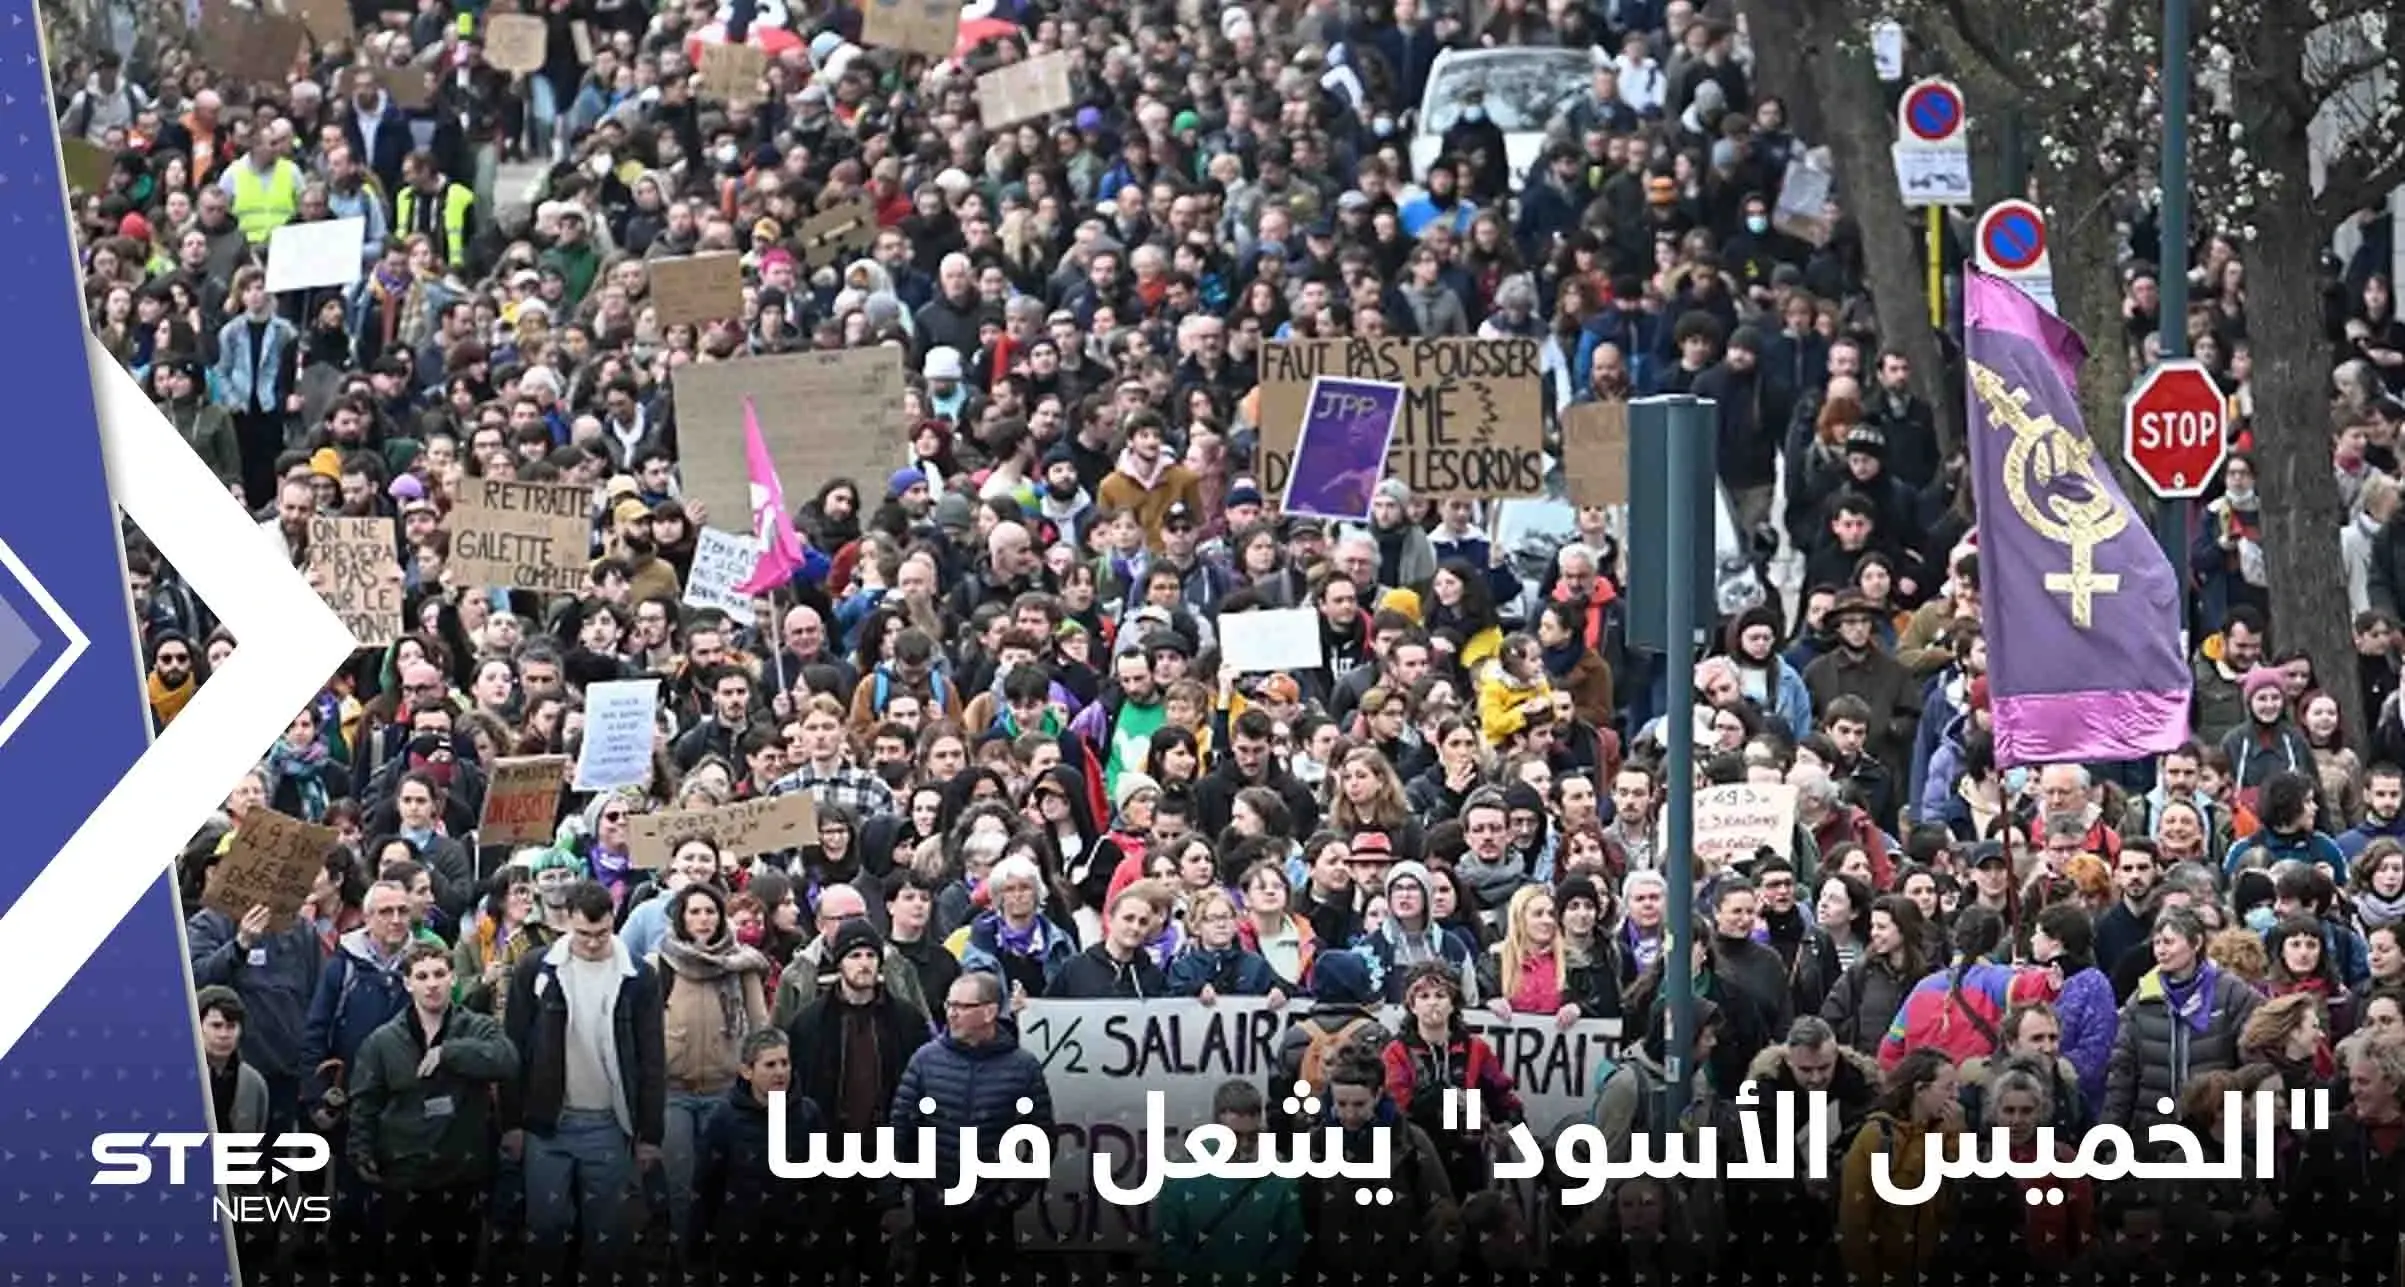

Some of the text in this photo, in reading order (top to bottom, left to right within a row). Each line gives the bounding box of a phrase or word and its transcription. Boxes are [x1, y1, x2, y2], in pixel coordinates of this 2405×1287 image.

[1262, 337, 1541, 381] FAUT PAS POUSSER
[1391, 377, 1460, 448] MÉ
[2140, 410, 2217, 450] STOP
[484, 480, 593, 519] RETRAITE
[313, 519, 380, 541] ON NE
[456, 529, 554, 567] GALETTE
[335, 559, 378, 589] PAS
[364, 588, 392, 610] LE
[1466, 1024, 1622, 1097] TRAIT
